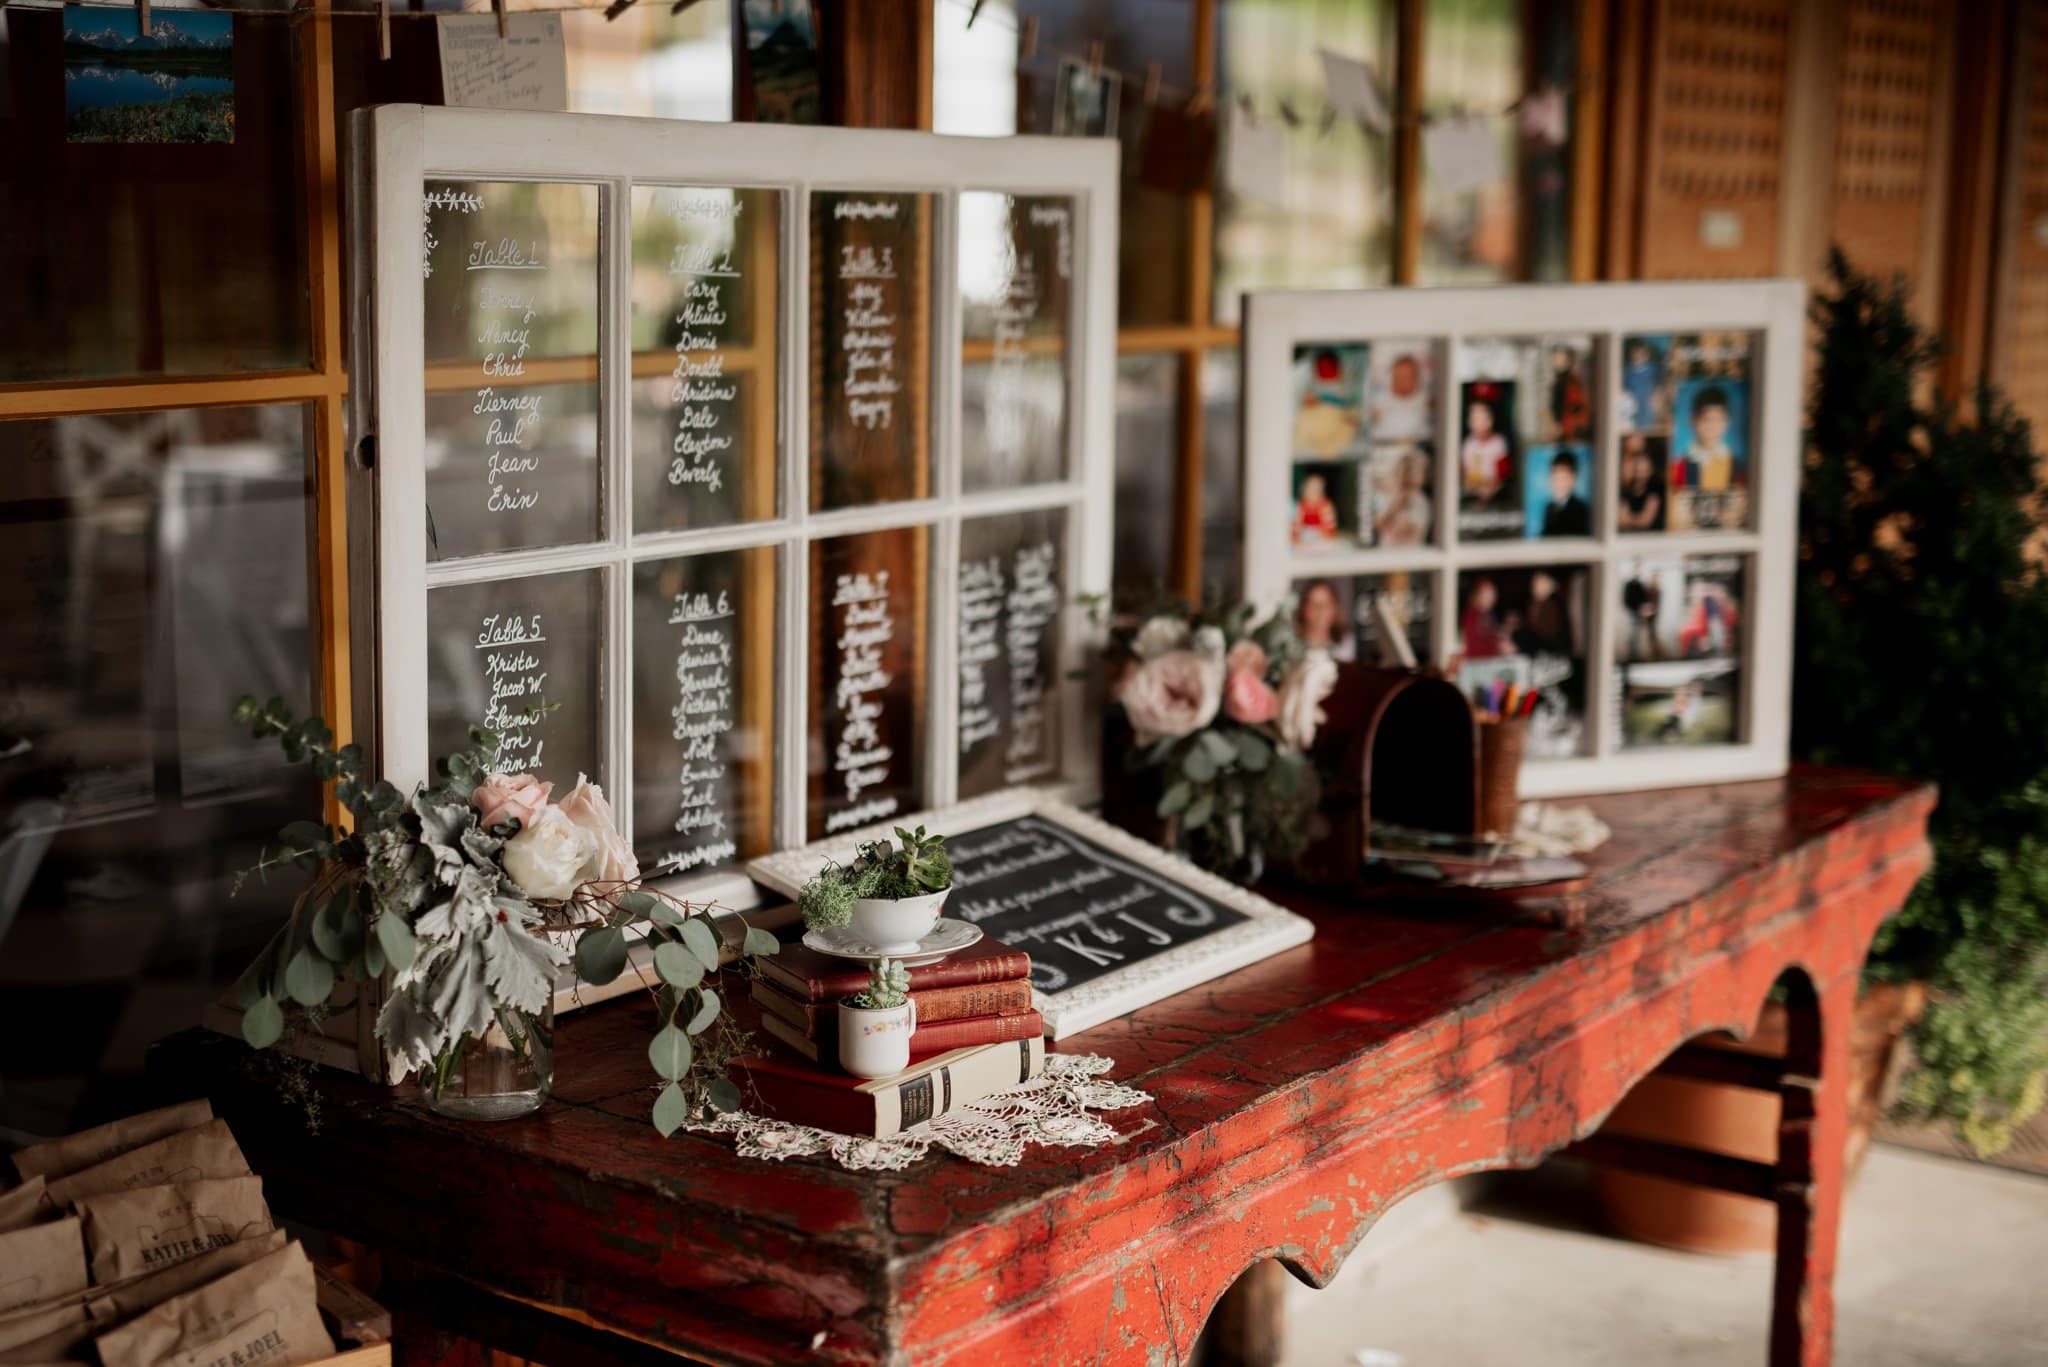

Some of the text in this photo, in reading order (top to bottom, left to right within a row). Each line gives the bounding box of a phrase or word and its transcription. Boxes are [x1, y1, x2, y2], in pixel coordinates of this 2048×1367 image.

[469, 238, 540, 267] Table 1
[718, 249, 734, 272] 2
[478, 321, 530, 358] Nancy
[482, 353, 525, 377] Chris
[473, 387, 542, 424] Tierney
[486, 418, 523, 446] Paul
[488, 451, 539, 484] Jean
[487, 484, 539, 512] Erin
[717, 590, 729, 615] 6
[479, 614, 542, 644] Table 5
[485, 650, 540, 682] Krista
[486, 678, 525, 713] Jacob
[484, 705, 540, 730] Eleanor
[494, 732, 532, 764] Jon
[480, 755, 527, 776] ustin
[1054, 931, 1126, 966] K
[1116, 911, 1172, 946] J
[141, 1240, 190, 1263] KATIE
[230, 1350, 245, 1367] &
[246, 1329, 285, 1359] JOEL
